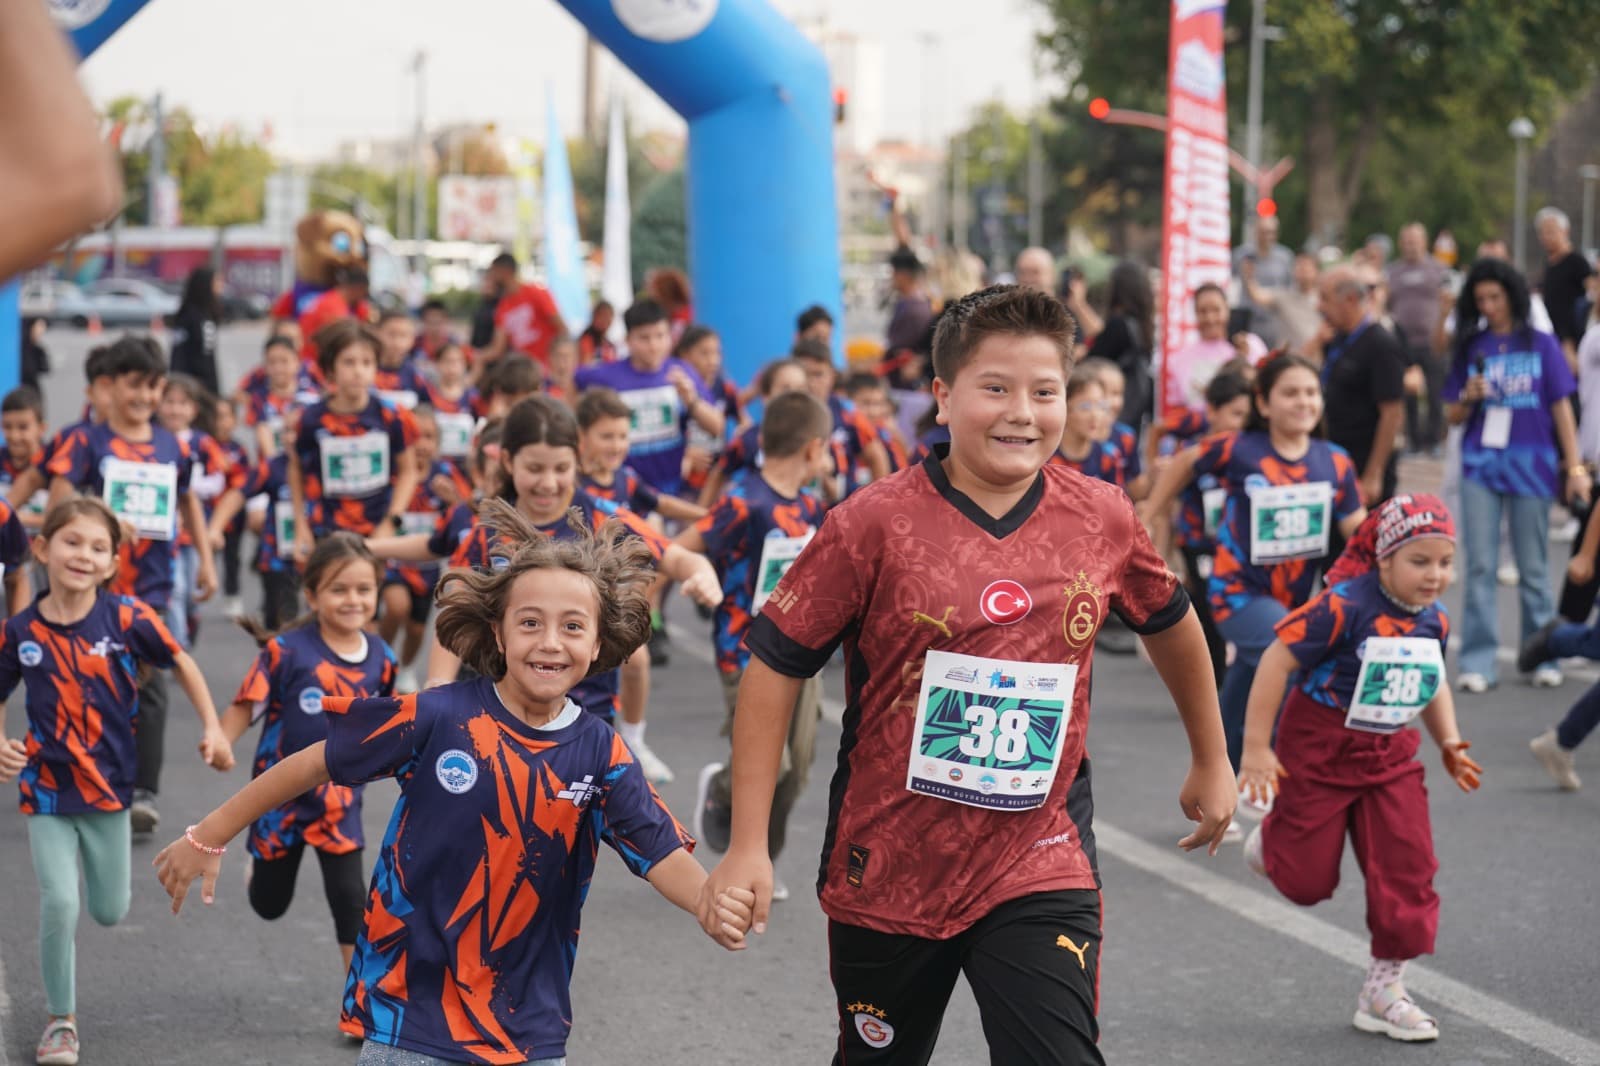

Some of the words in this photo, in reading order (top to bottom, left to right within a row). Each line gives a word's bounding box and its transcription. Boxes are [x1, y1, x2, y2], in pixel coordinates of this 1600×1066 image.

[1274, 508, 1310, 539] 38
[1381, 668, 1422, 704] 38
[959, 705, 1031, 762] 38
